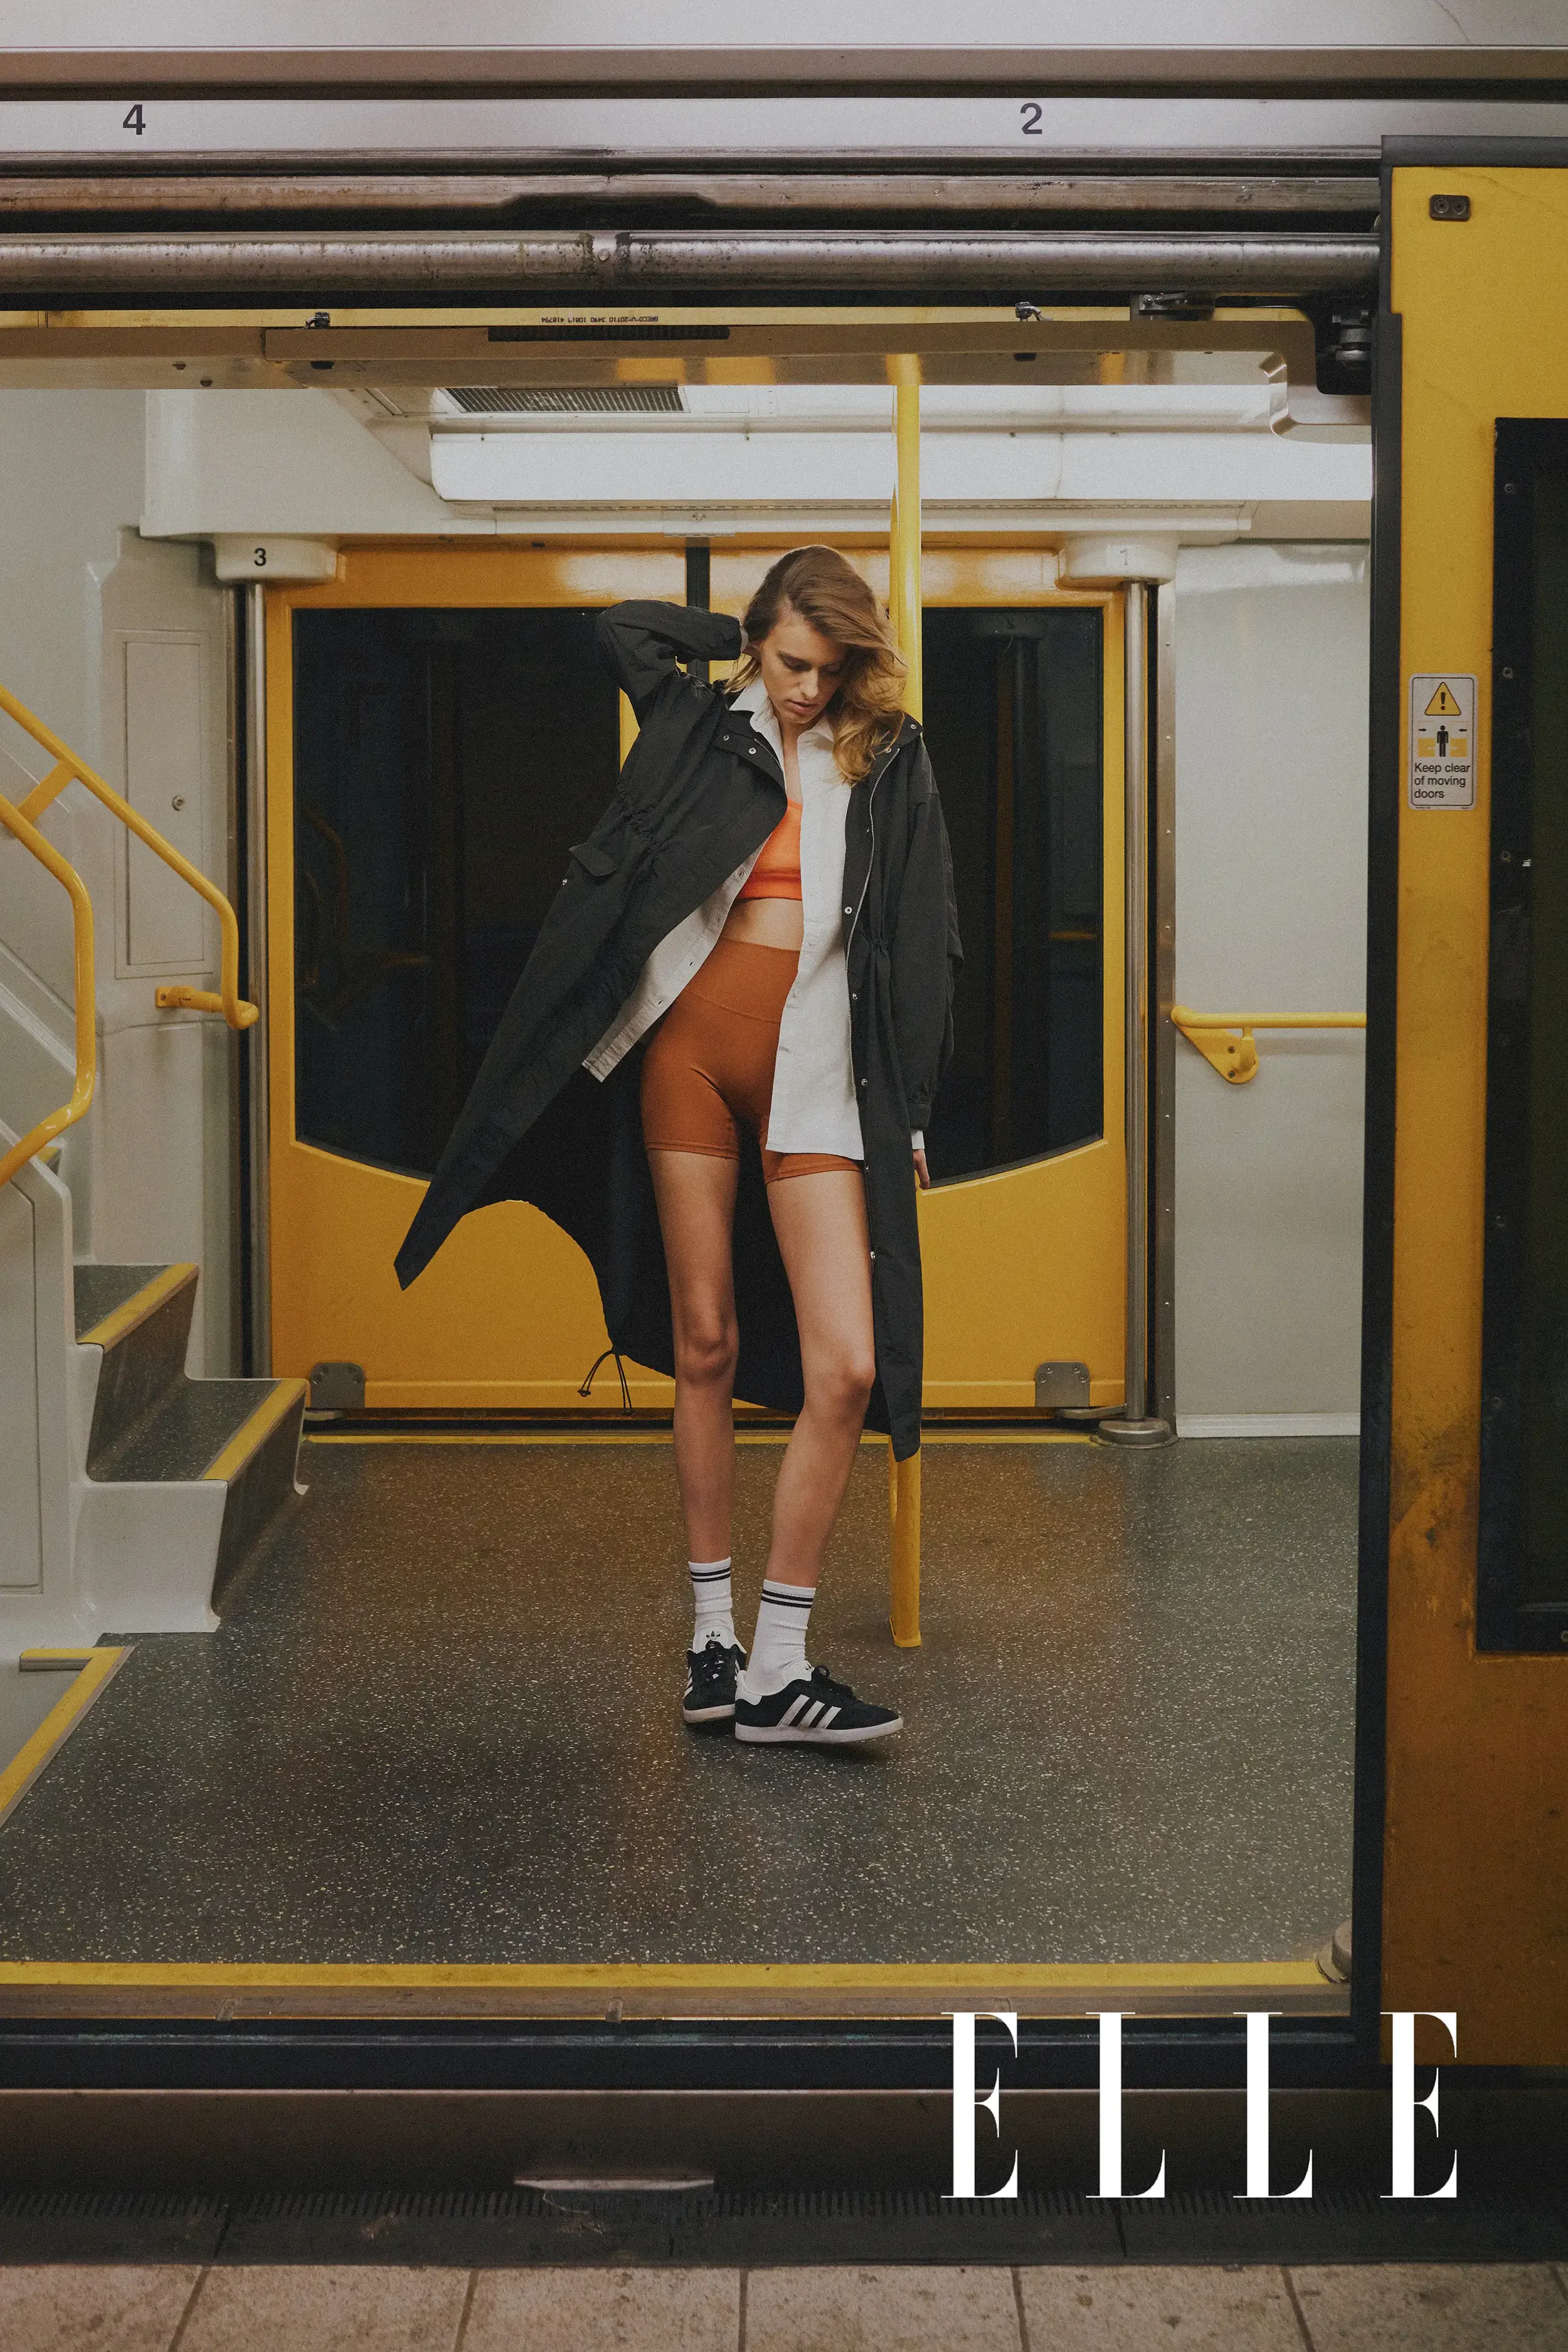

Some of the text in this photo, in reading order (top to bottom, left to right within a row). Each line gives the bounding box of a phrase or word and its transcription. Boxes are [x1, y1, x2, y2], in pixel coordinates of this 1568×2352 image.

[122, 104, 146, 136] 4
[1020, 102, 1042, 135] 2
[254, 548, 267, 567] 3
[1414, 762, 1471, 775] Keep clear
[1414, 775, 1466, 788] of moving
[1414, 788, 1445, 799] doors
